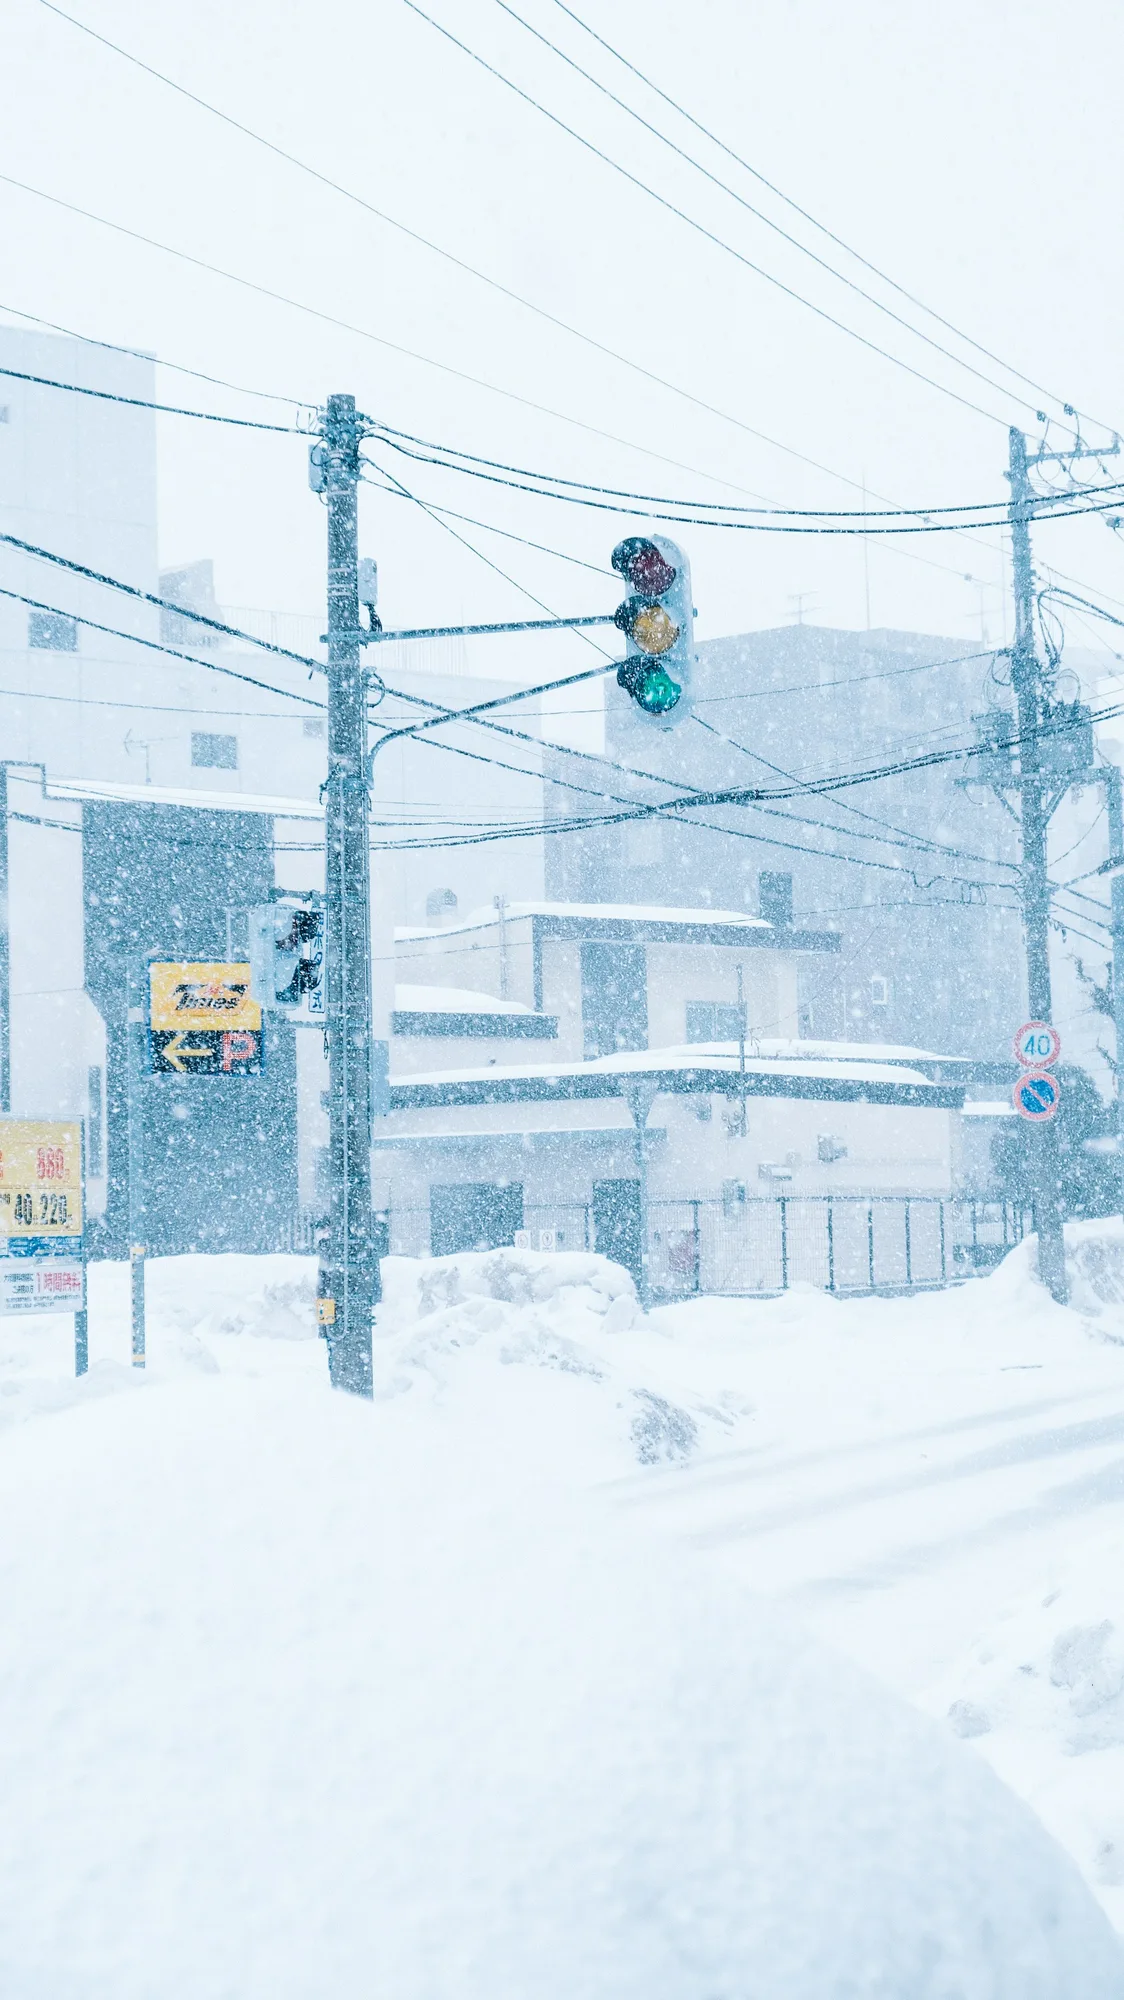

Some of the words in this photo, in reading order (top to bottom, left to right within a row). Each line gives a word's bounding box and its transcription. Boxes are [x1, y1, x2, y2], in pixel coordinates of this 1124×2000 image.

[173, 984, 249, 1011] Times
[222, 1033, 256, 1071] P
[1024, 1035, 1050, 1056] 40
